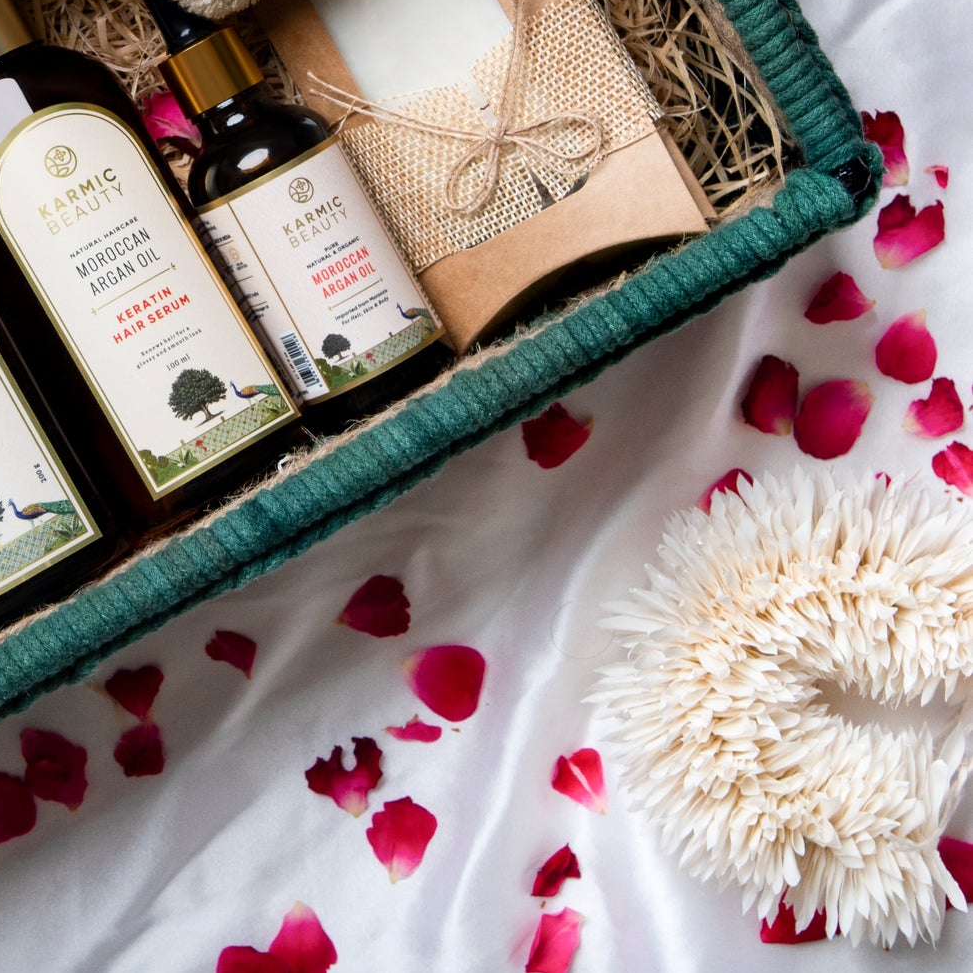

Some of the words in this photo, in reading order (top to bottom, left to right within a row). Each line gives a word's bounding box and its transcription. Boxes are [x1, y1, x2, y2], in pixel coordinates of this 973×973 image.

[38, 168, 117, 218] KARMIC
[46, 182, 124, 236] BEAUTY
[283, 196, 342, 235] KARMIC
[289, 207, 348, 248] BEAUTY
[69, 237, 103, 259] NATURAL
[103, 216, 138, 239] HAIRCARE
[75, 227, 151, 279] MOROCCAN
[306, 253, 332, 269] NATURAL
[337, 235, 360, 252] ORGANIC
[323, 241, 339, 252] PURE
[89, 260, 136, 296] ARGAN
[136, 247, 161, 268] OIL
[311, 245, 370, 285] MOROCCAN
[322, 271, 359, 299] ARGAN
[358, 261, 376, 278] OIL
[112, 319, 146, 344] HAIR
[147, 294, 190, 323] SERUM
[116, 286, 172, 324] KERATIN
[334, 305, 358, 321] Imported
[357, 299, 370, 308] from
[341, 318, 350, 326] For
[378, 296, 389, 305] Body
[136, 355, 155, 369] glossy
[156, 347, 167, 357] and
[167, 336, 189, 351] smooth
[188, 328, 202, 338] look
[140, 341, 163, 356] Renews
[162, 334, 176, 344] hair
[175, 328, 185, 336] for
[165, 359, 180, 371] 100
[180, 353, 191, 363] ml
[35, 469, 47, 483] 200
